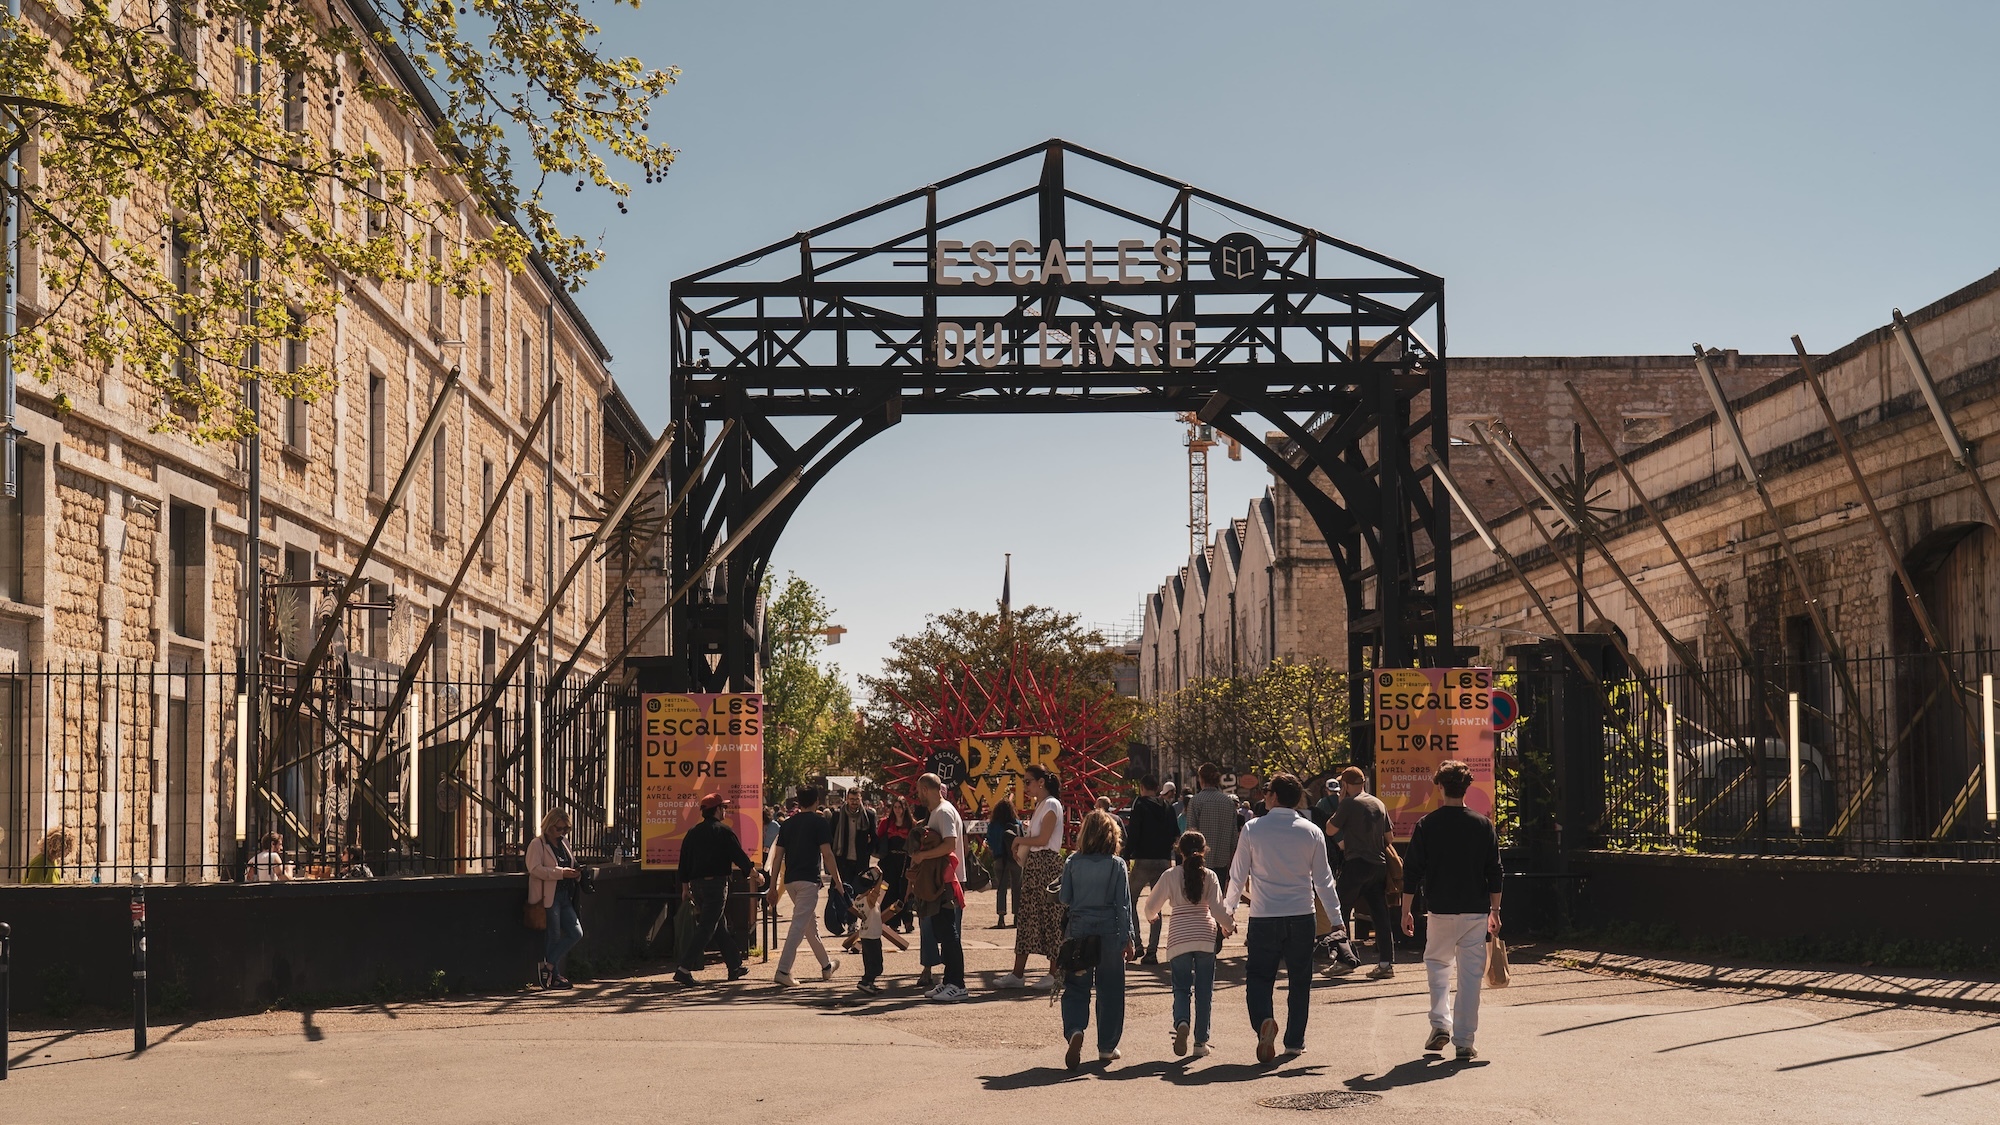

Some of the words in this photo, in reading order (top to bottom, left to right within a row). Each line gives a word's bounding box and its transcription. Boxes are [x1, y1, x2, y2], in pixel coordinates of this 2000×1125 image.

[936, 238, 1183, 286] ESCALES
[937, 321, 1003, 368] DU
[1038, 321, 1197, 368] LIVRE
[1380, 714, 1410, 731] DU
[1446, 717, 1489, 726] DARWIN
[646, 740, 678, 757] DU
[715, 743, 758, 752] DARWIN
[934, 752, 962, 764] ESCALES
